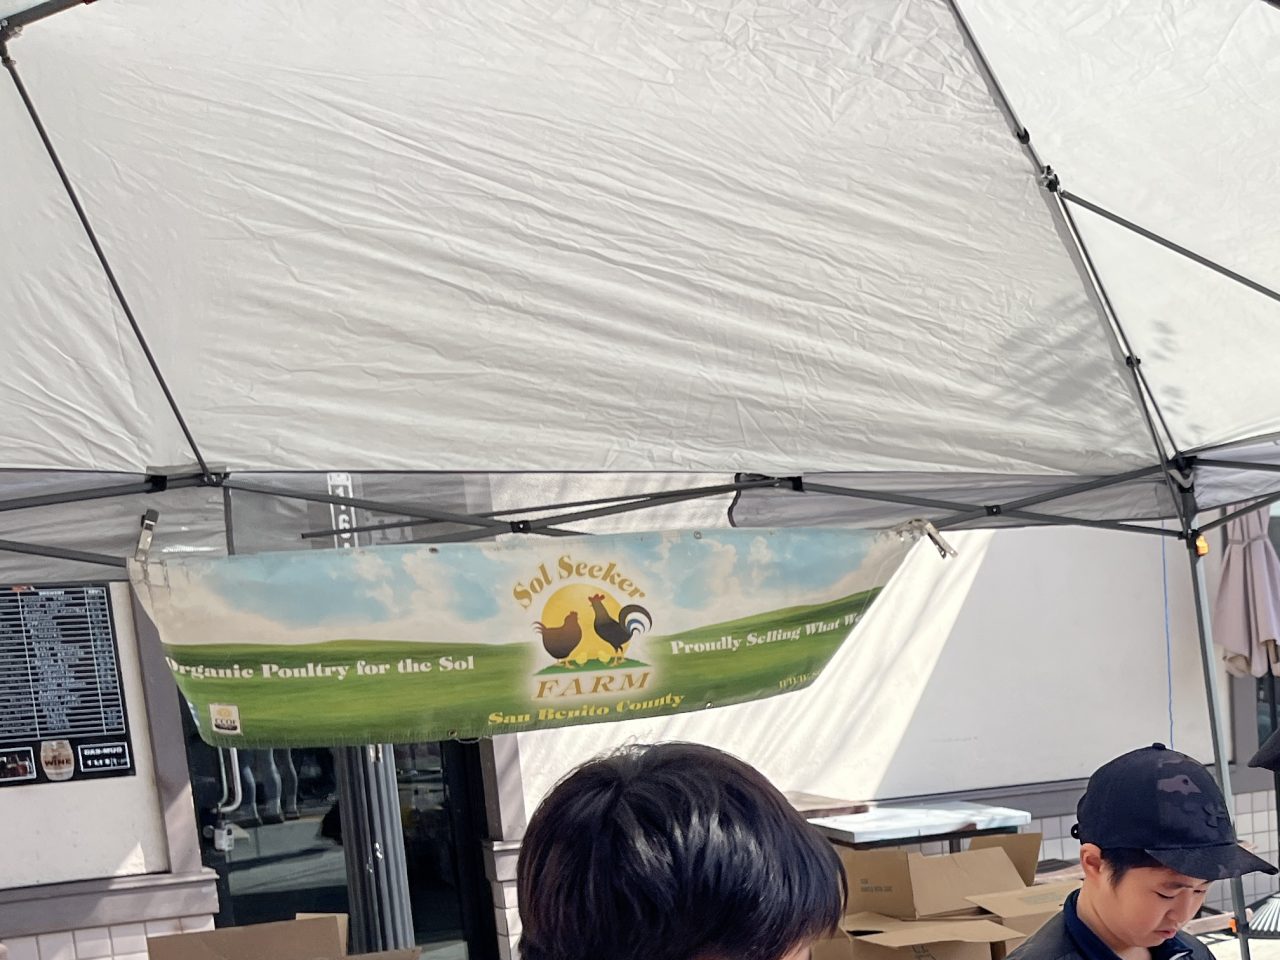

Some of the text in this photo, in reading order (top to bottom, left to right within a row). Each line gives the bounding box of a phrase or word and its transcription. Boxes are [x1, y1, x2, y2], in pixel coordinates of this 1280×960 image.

[513, 554, 646, 610] Sol Seeker
[670, 635, 742, 655] Proudly
[746, 627, 802, 647] Selling
[805, 619, 840, 636] What
[261, 662, 350, 681] Poultry
[356, 660, 391, 675] for
[397, 658, 432, 673] the
[439, 655, 475, 672] Sol
[536, 672, 651, 699] FARM
[488, 692, 685, 726] San Benito County
